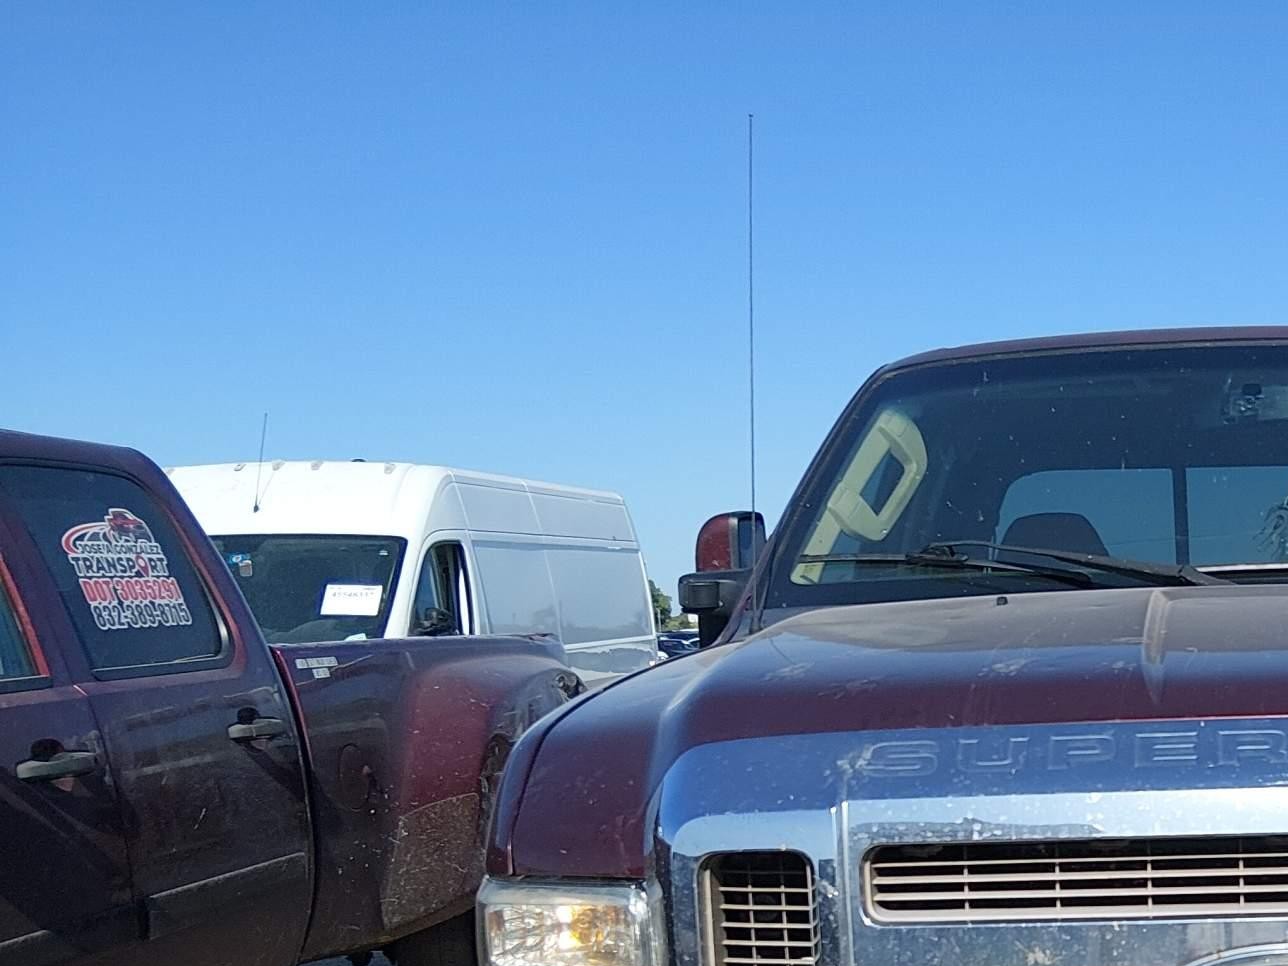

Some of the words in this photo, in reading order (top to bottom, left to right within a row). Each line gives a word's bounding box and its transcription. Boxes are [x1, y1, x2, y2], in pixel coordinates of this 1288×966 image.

[70, 555, 168, 577] TRANSPORT
[81, 580, 117, 602] DOT
[114, 579, 182, 602] 3035291
[93, 602, 192, 627] 832-389-8715
